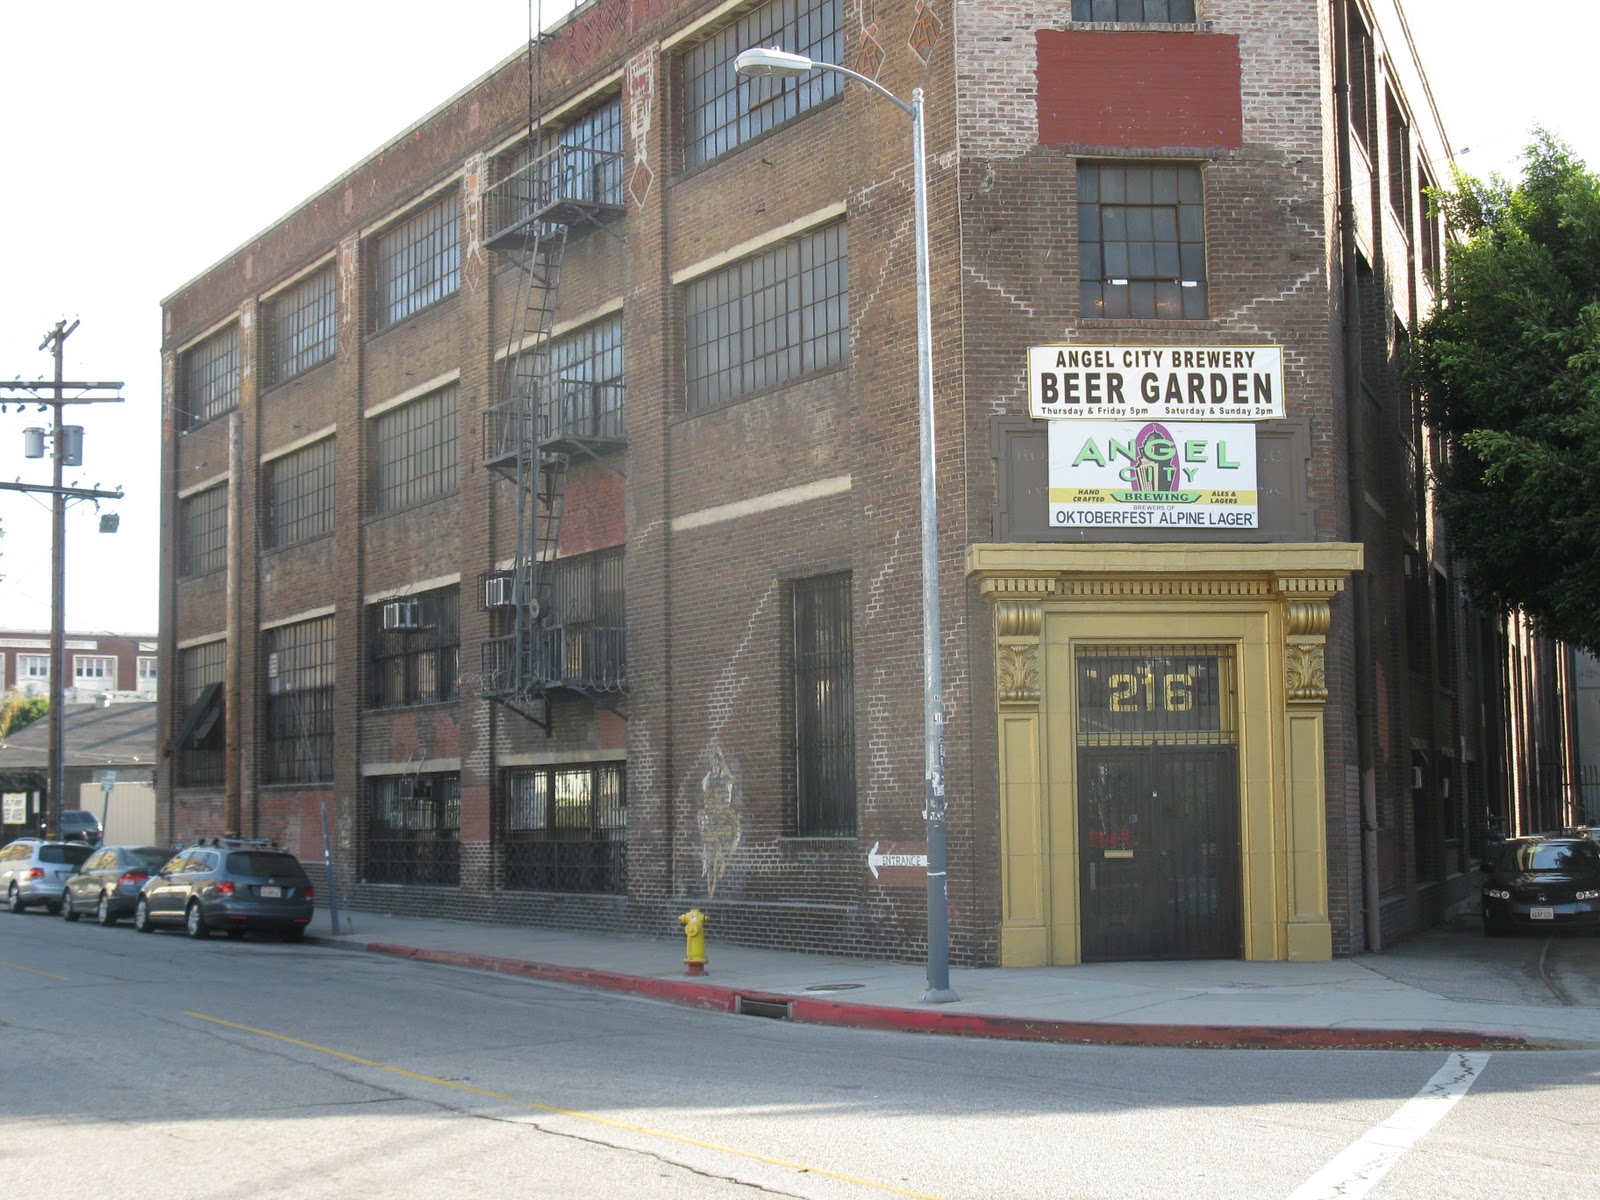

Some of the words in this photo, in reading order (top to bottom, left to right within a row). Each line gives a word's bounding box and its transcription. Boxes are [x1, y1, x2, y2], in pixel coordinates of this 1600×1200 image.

[1056, 350, 1115, 368] ANGEL
[1122, 350, 1163, 368] CITY
[1172, 350, 1255, 368] BREWERY
[1041, 372, 1126, 404] BEER
[1141, 372, 1272, 404] GARDEN
[1041, 407, 1084, 416] Thursday
[1097, 407, 1126, 416] Friday
[1130, 407, 1149, 416] 5pm
[1165, 407, 1206, 416] Saturday
[1219, 407, 1252, 416] Sunday
[1255, 407, 1274, 416] 2pm
[1071, 436, 1240, 469] ANGEL
[1118, 466, 1200, 482] CITY
[1124, 493, 1189, 501] BREWING
[1056, 511, 1154, 524] OKTOBERFEST
[1159, 511, 1205, 525] ALPINE
[1209, 512, 1253, 526] LAGER
[1109, 673, 1193, 712] 216
[882, 855, 921, 866] ENTRANCE
